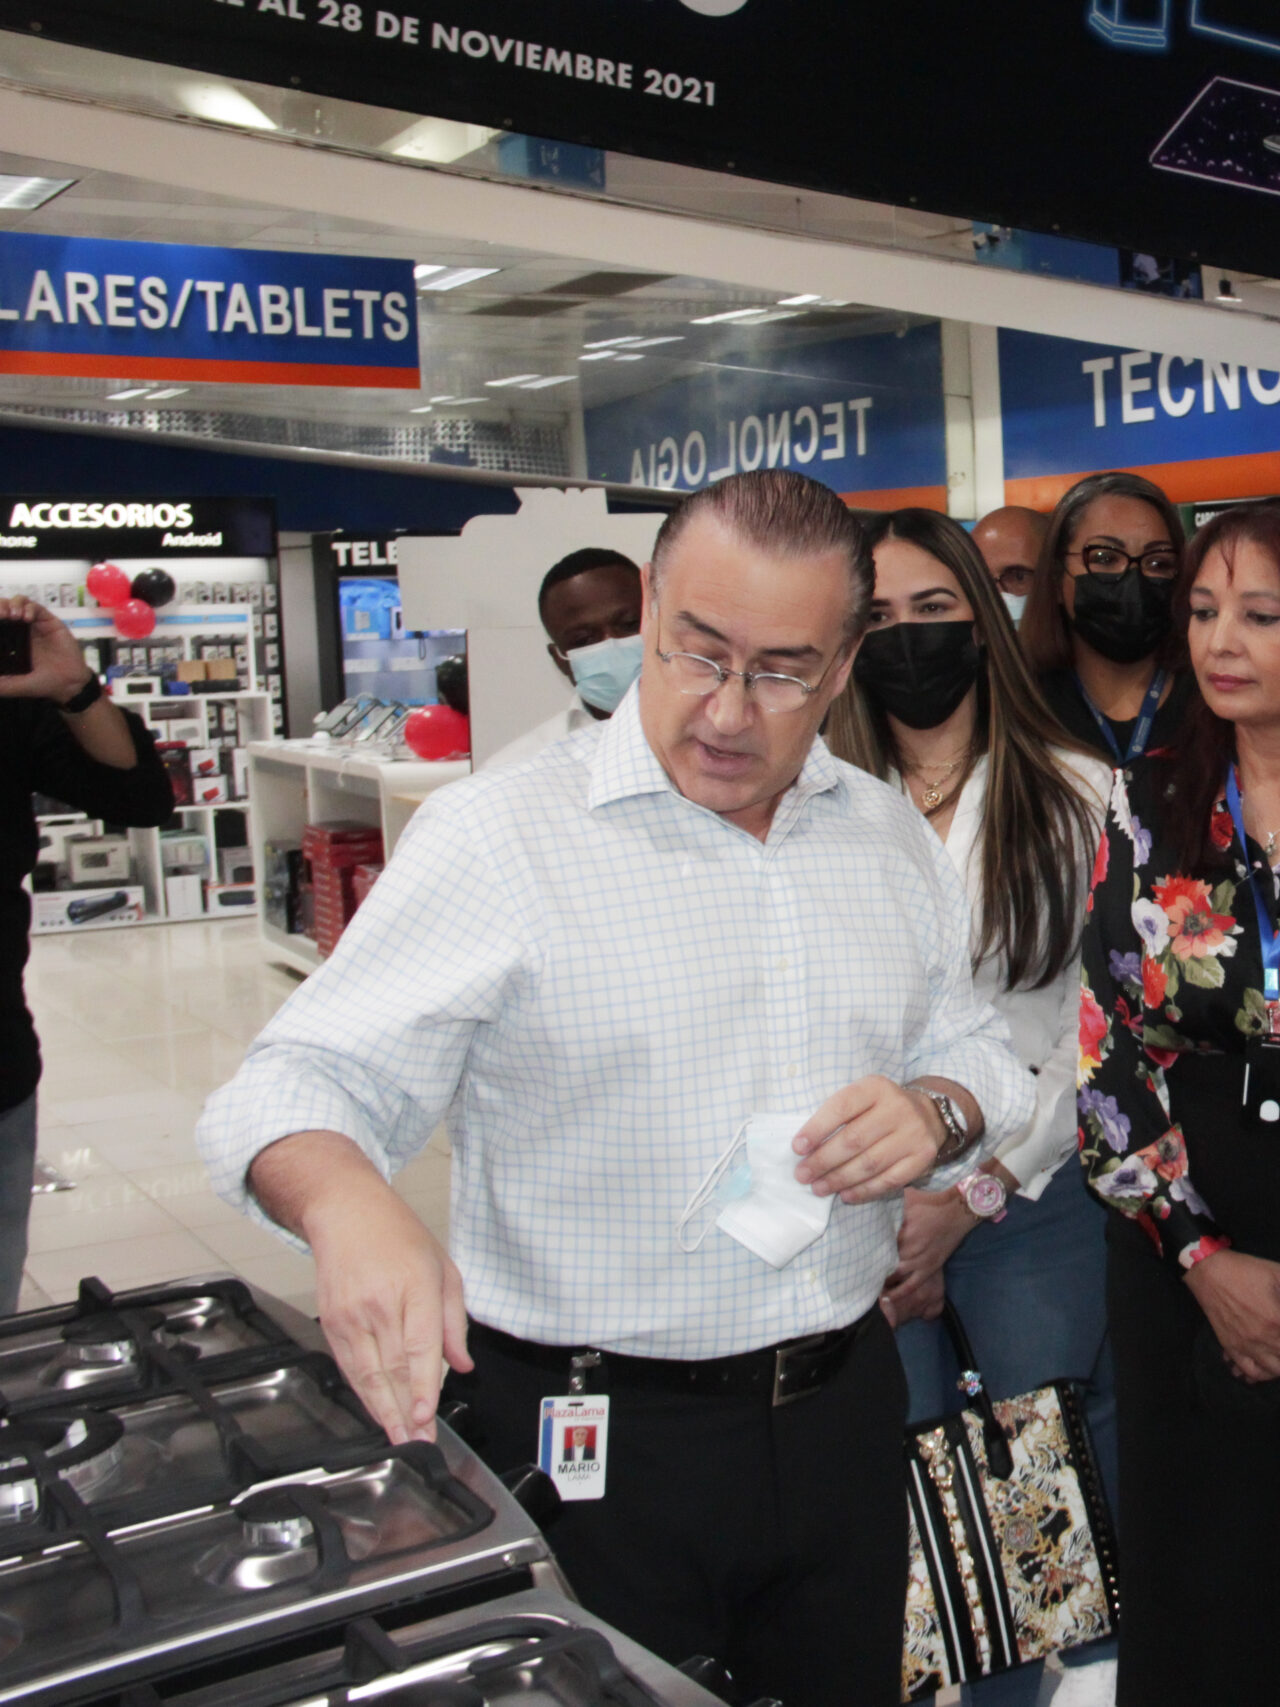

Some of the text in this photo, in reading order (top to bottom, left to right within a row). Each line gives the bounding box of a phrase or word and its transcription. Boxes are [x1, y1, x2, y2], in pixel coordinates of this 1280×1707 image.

[318, 0, 363, 32] 28
[376, 10, 420, 45] DE
[431, 22, 634, 89] NOVIEMBRE
[643, 68, 715, 106] 2021
[9, 503, 193, 529] ACCESORIOS
[161, 532, 223, 547] Android
[558, 1462, 601, 1475] MARIO
